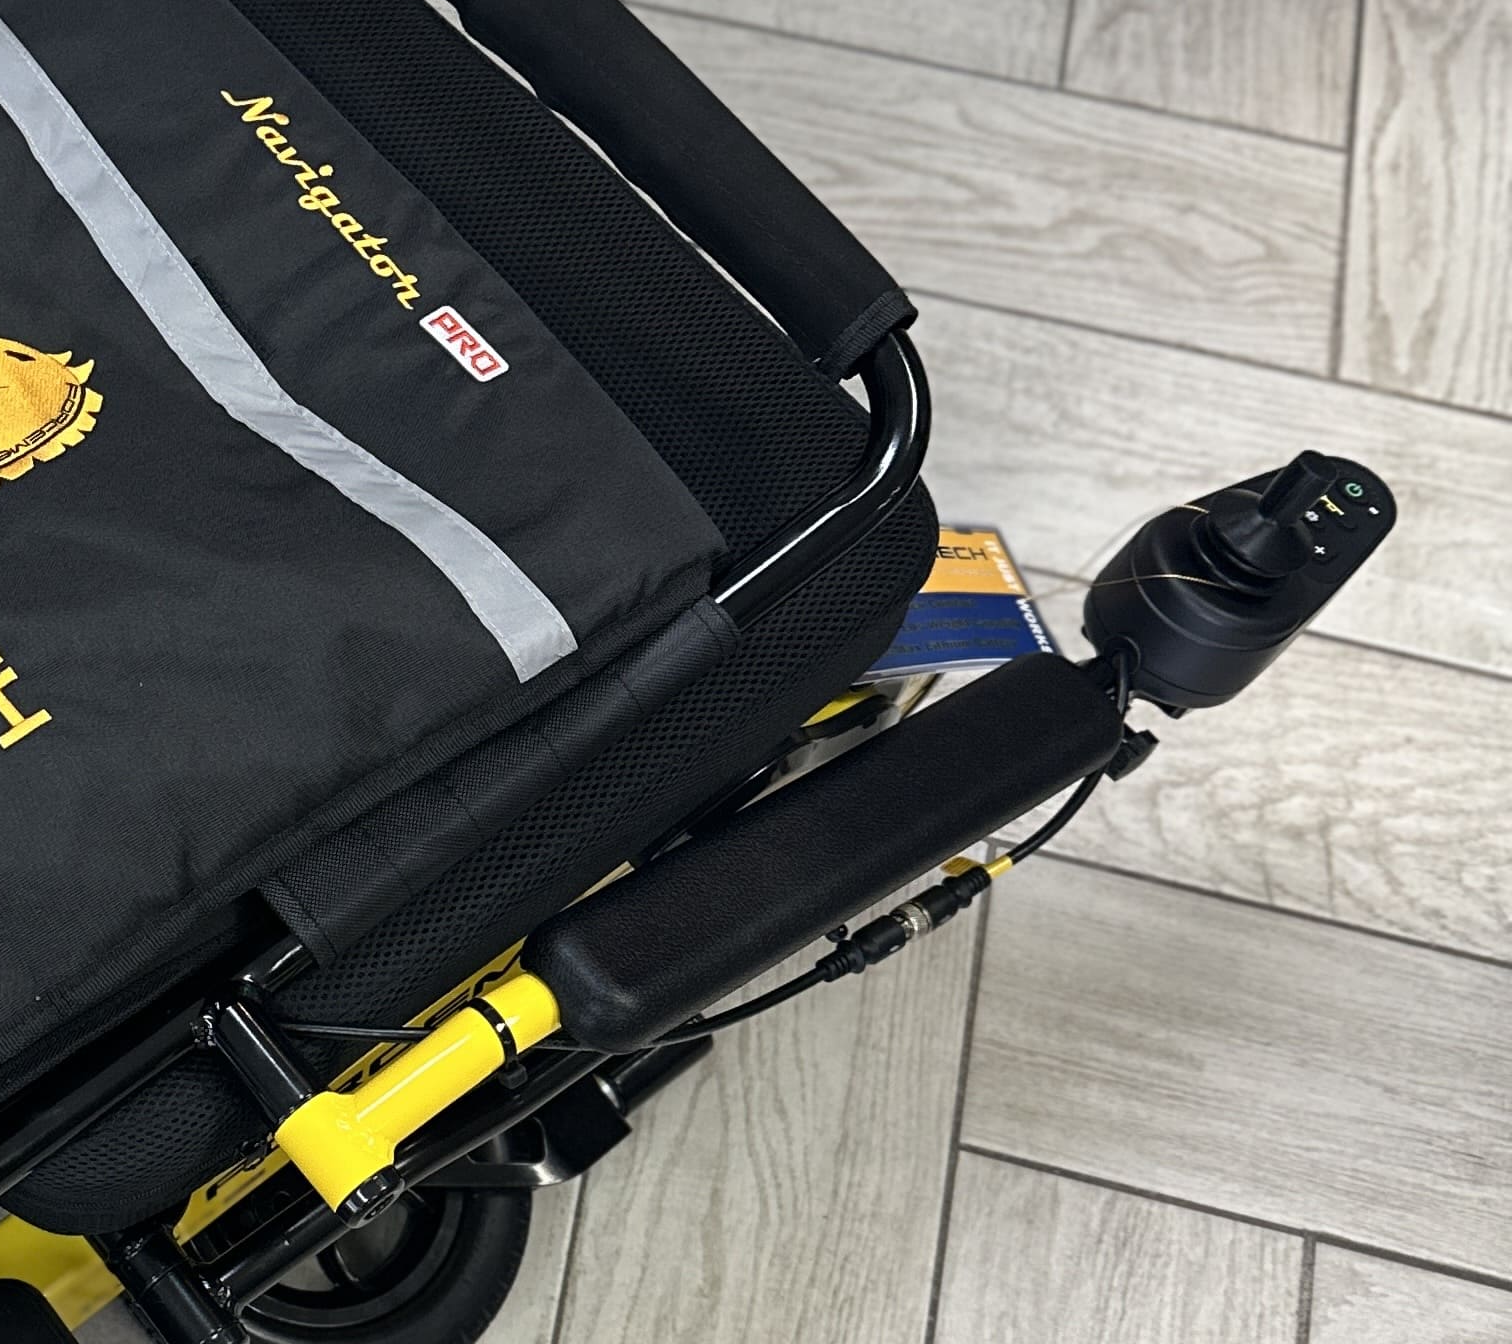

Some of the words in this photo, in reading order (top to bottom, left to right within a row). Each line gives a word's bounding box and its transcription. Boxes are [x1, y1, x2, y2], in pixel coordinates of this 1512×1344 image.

[219, 88, 421, 311] Navigator
[428, 311, 502, 377] PRO
[934, 545, 989, 561] ECH
[1016, 597, 1055, 654] WORKS
